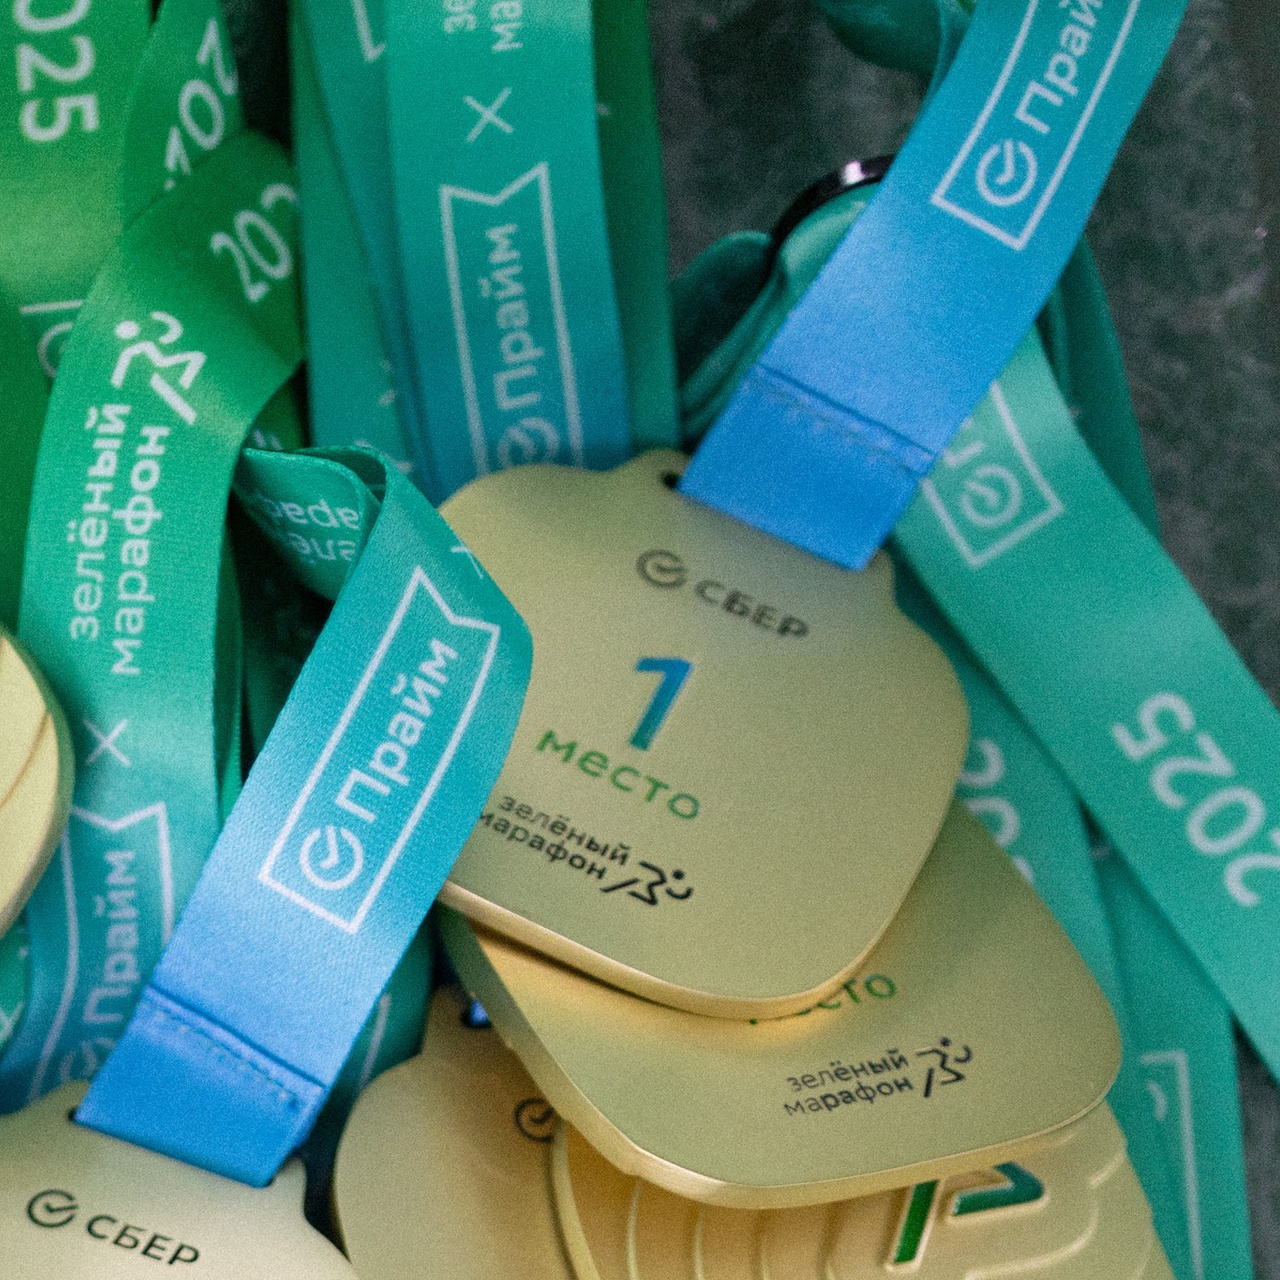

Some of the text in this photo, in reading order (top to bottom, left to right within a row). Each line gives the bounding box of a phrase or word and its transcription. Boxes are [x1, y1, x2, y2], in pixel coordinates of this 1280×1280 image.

[1014, 0, 1104, 135] Прай
[480, 222, 546, 412] Прайм
[69, 402, 131, 641] зелёный
[109, 425, 172, 676] марафон
[694, 578, 811, 640] СБЕР
[339, 636, 461, 822] Прайм
[628, 656, 694, 751] 1
[535, 728, 701, 822] место
[496, 794, 632, 867] зелёный
[82, 850, 142, 1024] Прайм
[782, 1075, 916, 1117] марафон
[786, 1047, 911, 1093] зелёный
[84, 1212, 202, 1269] СБЕР
